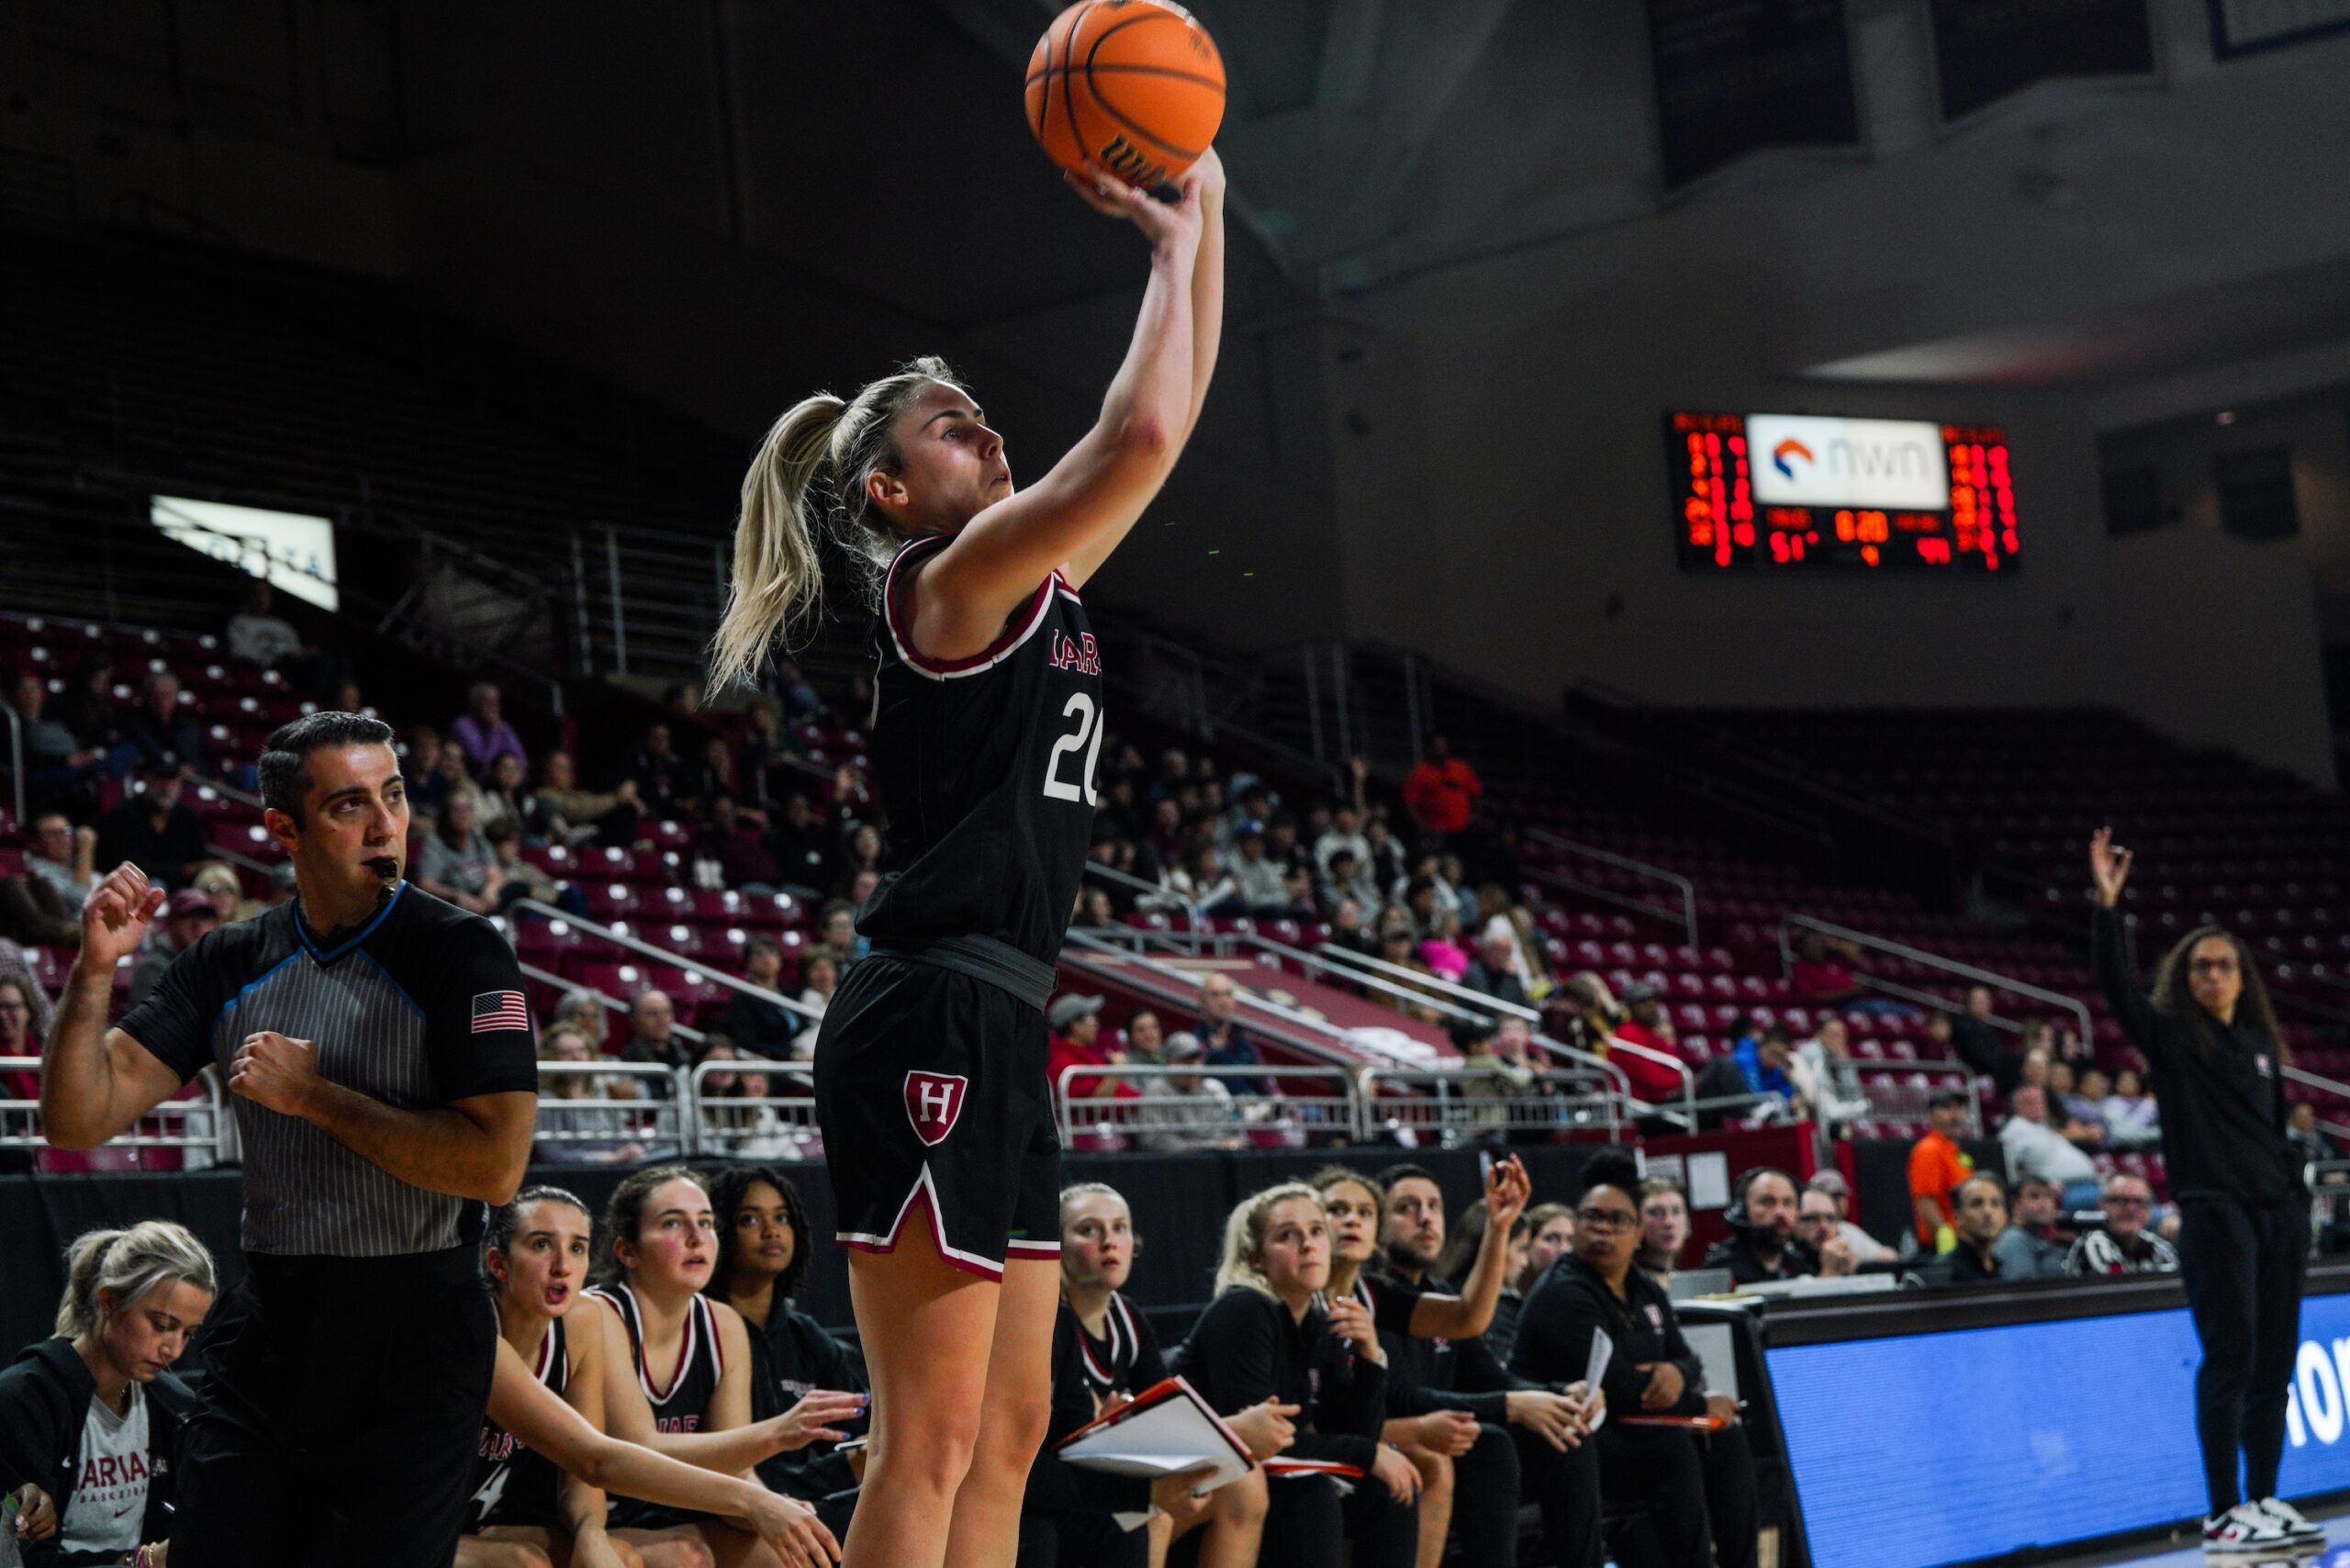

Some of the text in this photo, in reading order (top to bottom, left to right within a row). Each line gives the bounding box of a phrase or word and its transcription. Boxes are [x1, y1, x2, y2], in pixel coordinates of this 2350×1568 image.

[1827, 436, 1928, 480] nwn
[1048, 628, 1102, 676] AR
[920, 1081, 955, 1126] H
